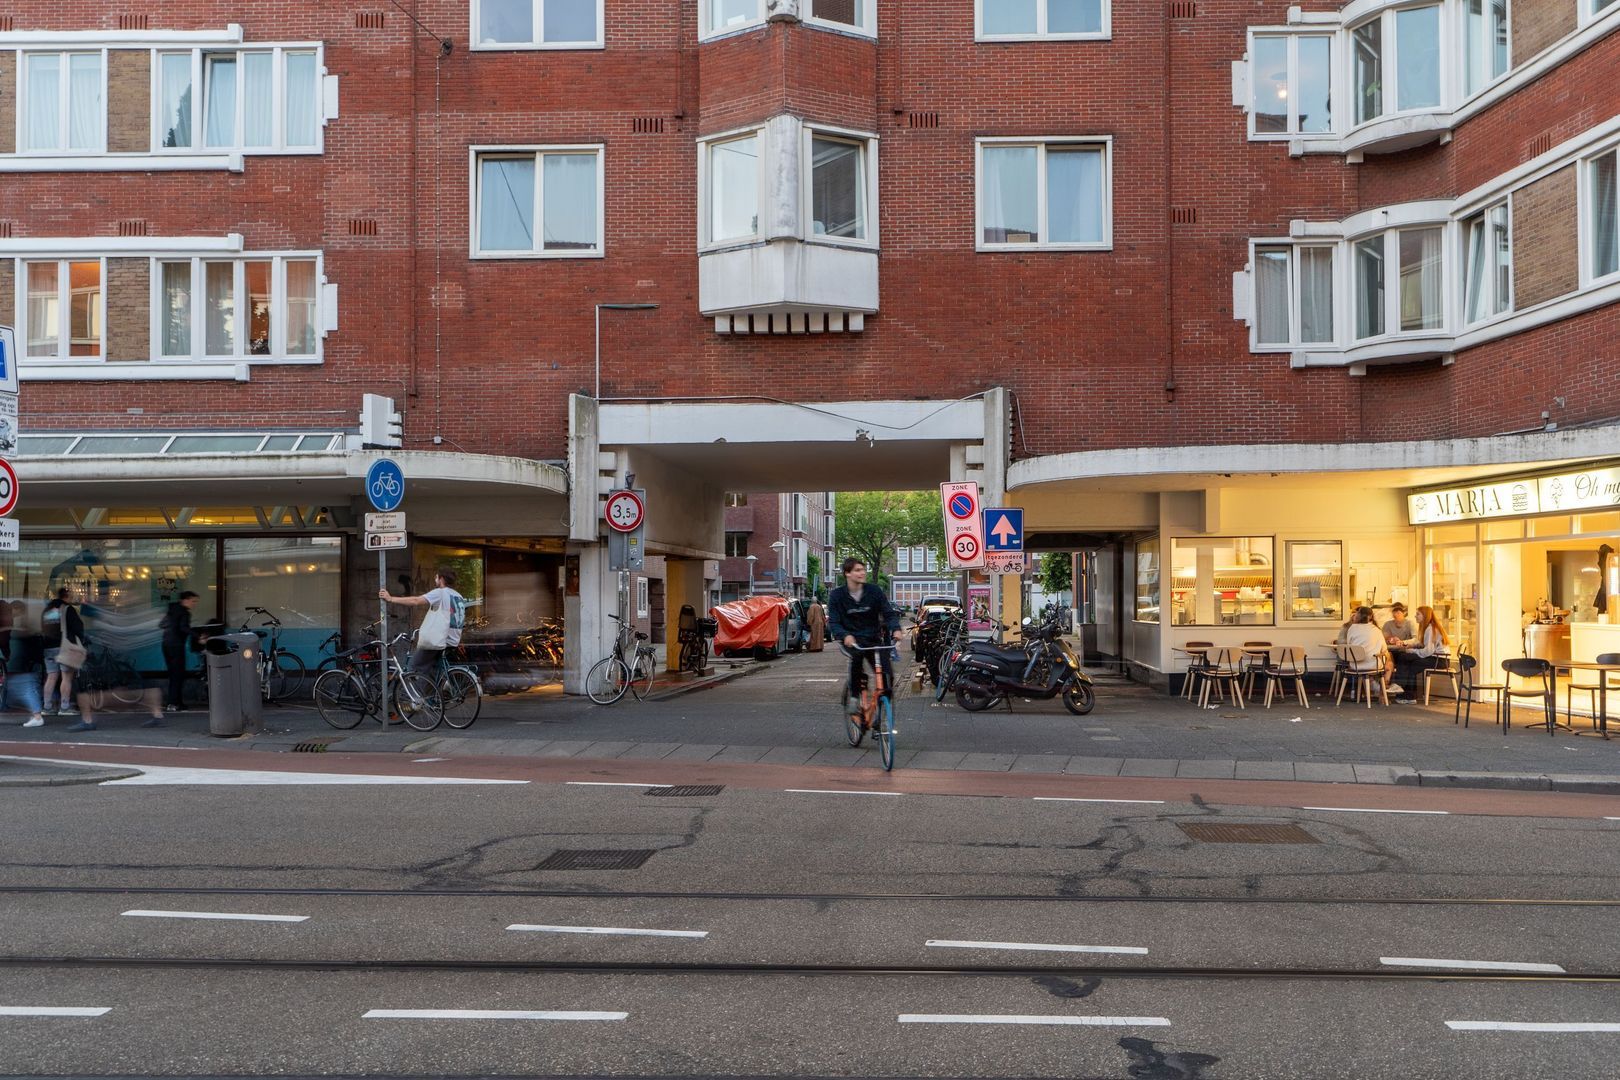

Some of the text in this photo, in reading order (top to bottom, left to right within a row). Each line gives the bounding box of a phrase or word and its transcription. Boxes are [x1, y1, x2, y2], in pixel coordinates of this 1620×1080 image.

[1575, 474, 1598, 499] Oh
[1436, 488, 1502, 517] MARJA
[957, 541, 975, 553] 30
